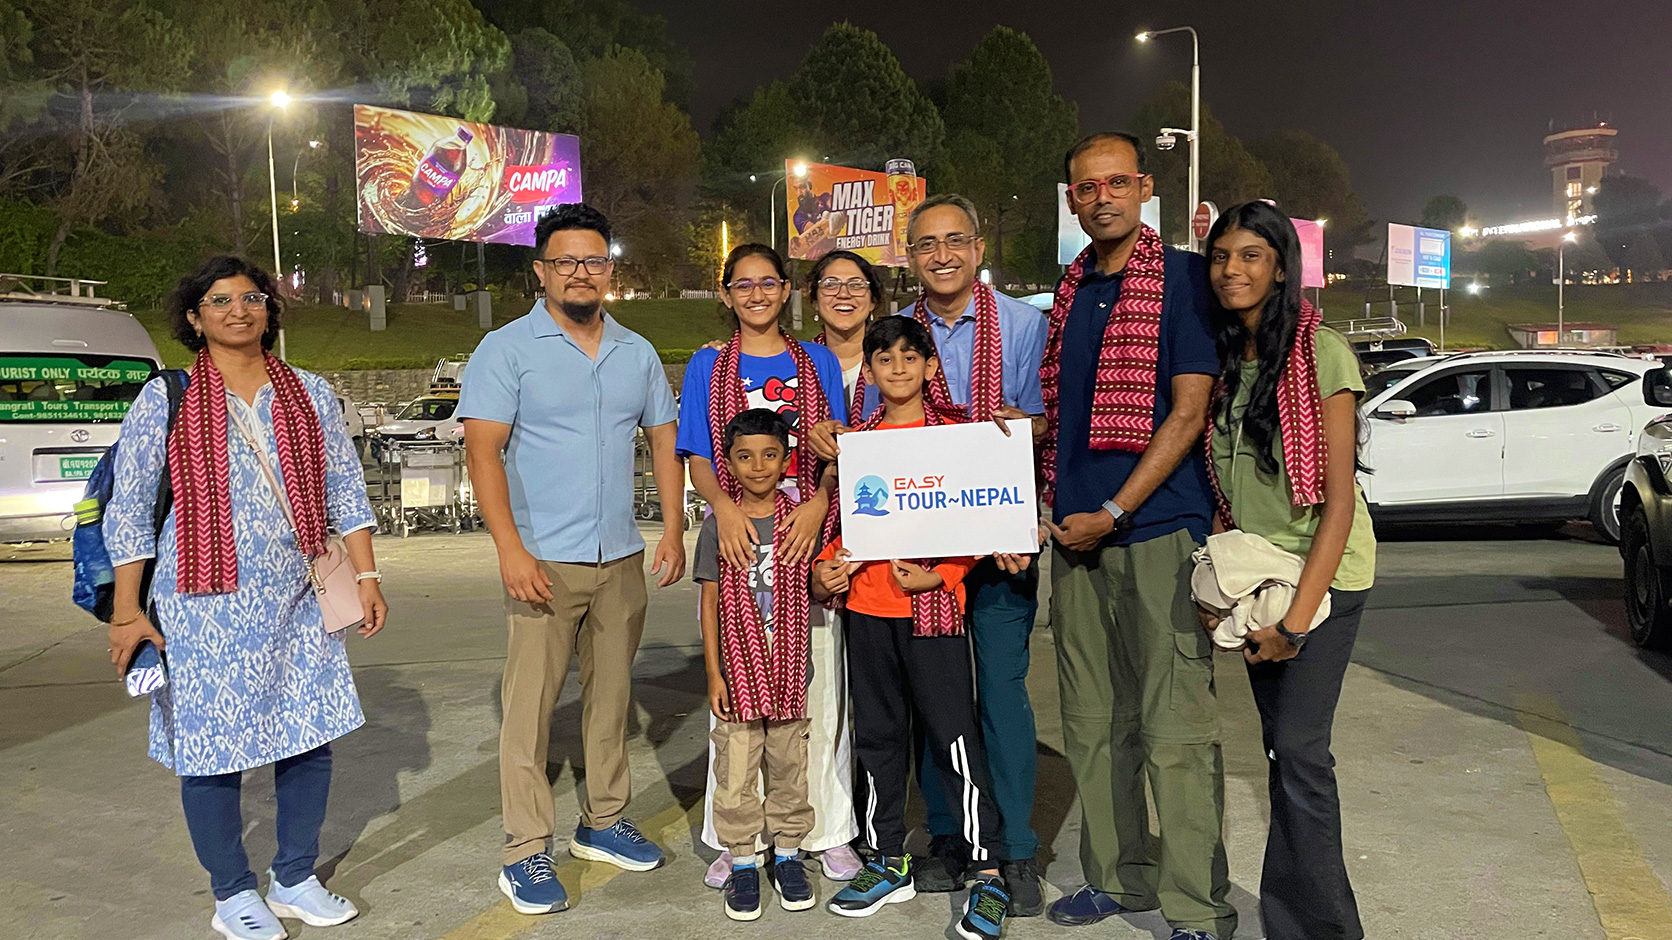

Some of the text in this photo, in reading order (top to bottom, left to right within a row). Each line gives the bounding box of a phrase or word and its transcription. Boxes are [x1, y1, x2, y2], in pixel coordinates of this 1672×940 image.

[420, 163, 453, 187] CAMPA
[509, 168, 567, 192] CAMPA
[832, 181, 875, 210] MAX
[846, 205, 895, 236] TIGER
[836, 235, 867, 249] ENERGY
[867, 233, 890, 245] DRINK
[0, 367, 37, 379] URIST
[41, 367, 70, 379] ONLY
[41, 401, 69, 410] Tours
[73, 401, 119, 412] Transport
[894, 475, 945, 491] EASY
